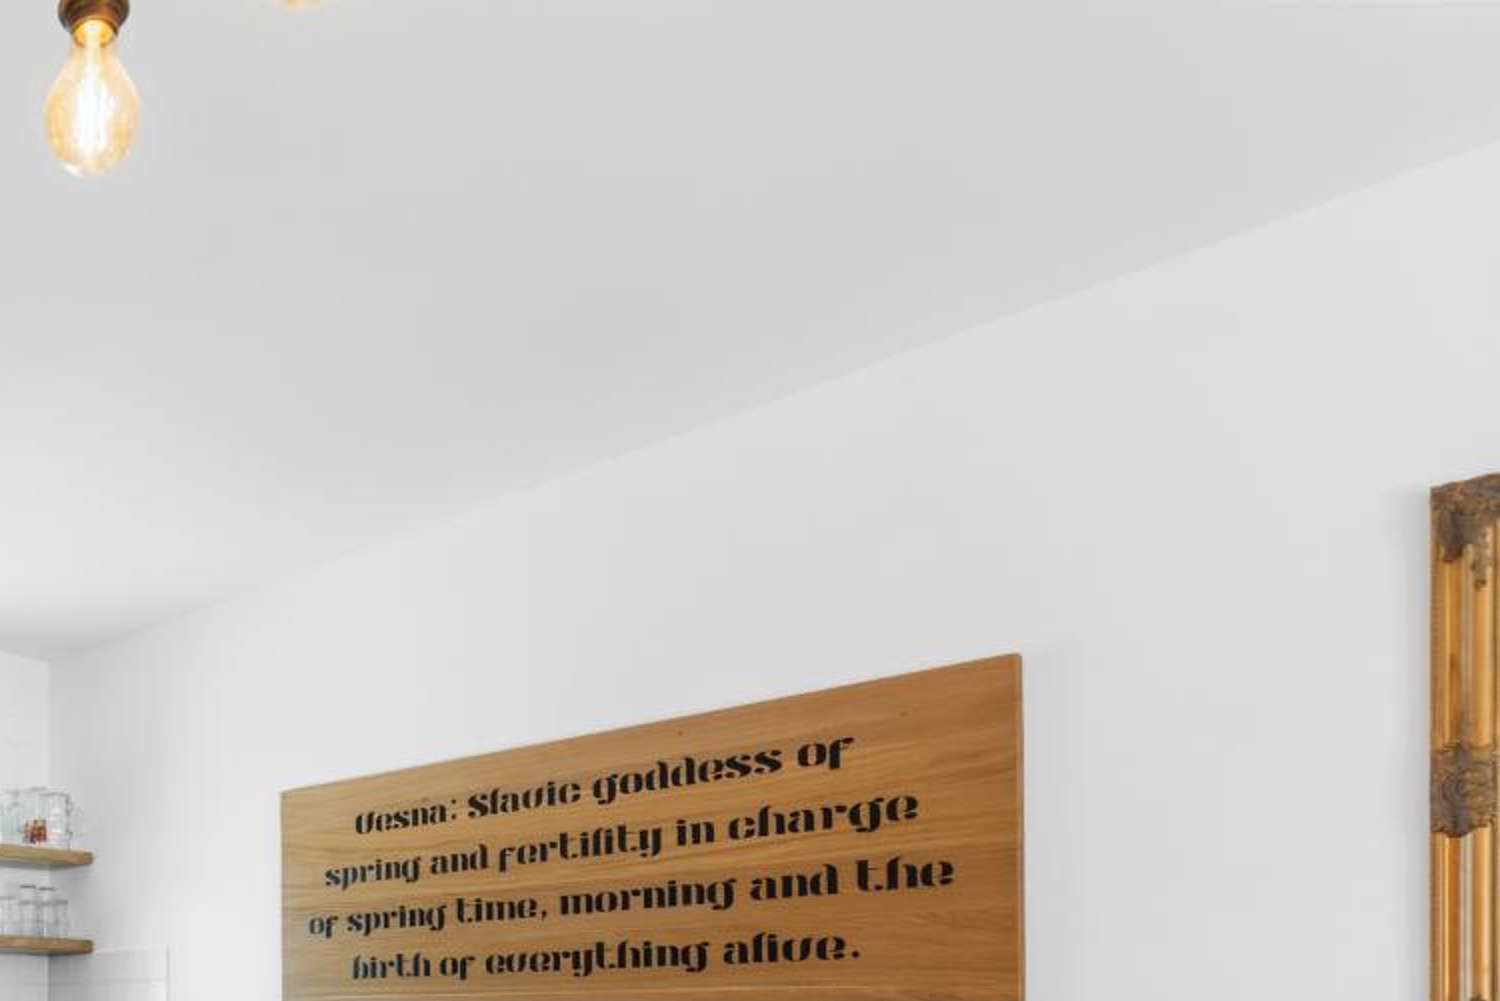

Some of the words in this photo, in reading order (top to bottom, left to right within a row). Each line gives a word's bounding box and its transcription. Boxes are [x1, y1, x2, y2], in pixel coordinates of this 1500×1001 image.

[467, 781, 581, 818] Slavic
[592, 749, 783, 805] goddess
[797, 737, 855, 770] of
[325, 856, 421, 890] spring
[430, 843, 489, 875] and
[498, 824, 662, 873] fertility
[675, 819, 715, 847] in
[728, 795, 919, 840] charge
[309, 916, 339, 939] of
[347, 904, 447, 937] spring
[456, 897, 547, 924] time,
[559, 877, 737, 916] morning
[749, 863, 839, 901] and
[855, 855, 955, 892] the
[352, 952, 431, 980] birth
[439, 955, 476, 981] of
[485, 940, 710, 978] everything
[723, 932, 860, 965] alive.
